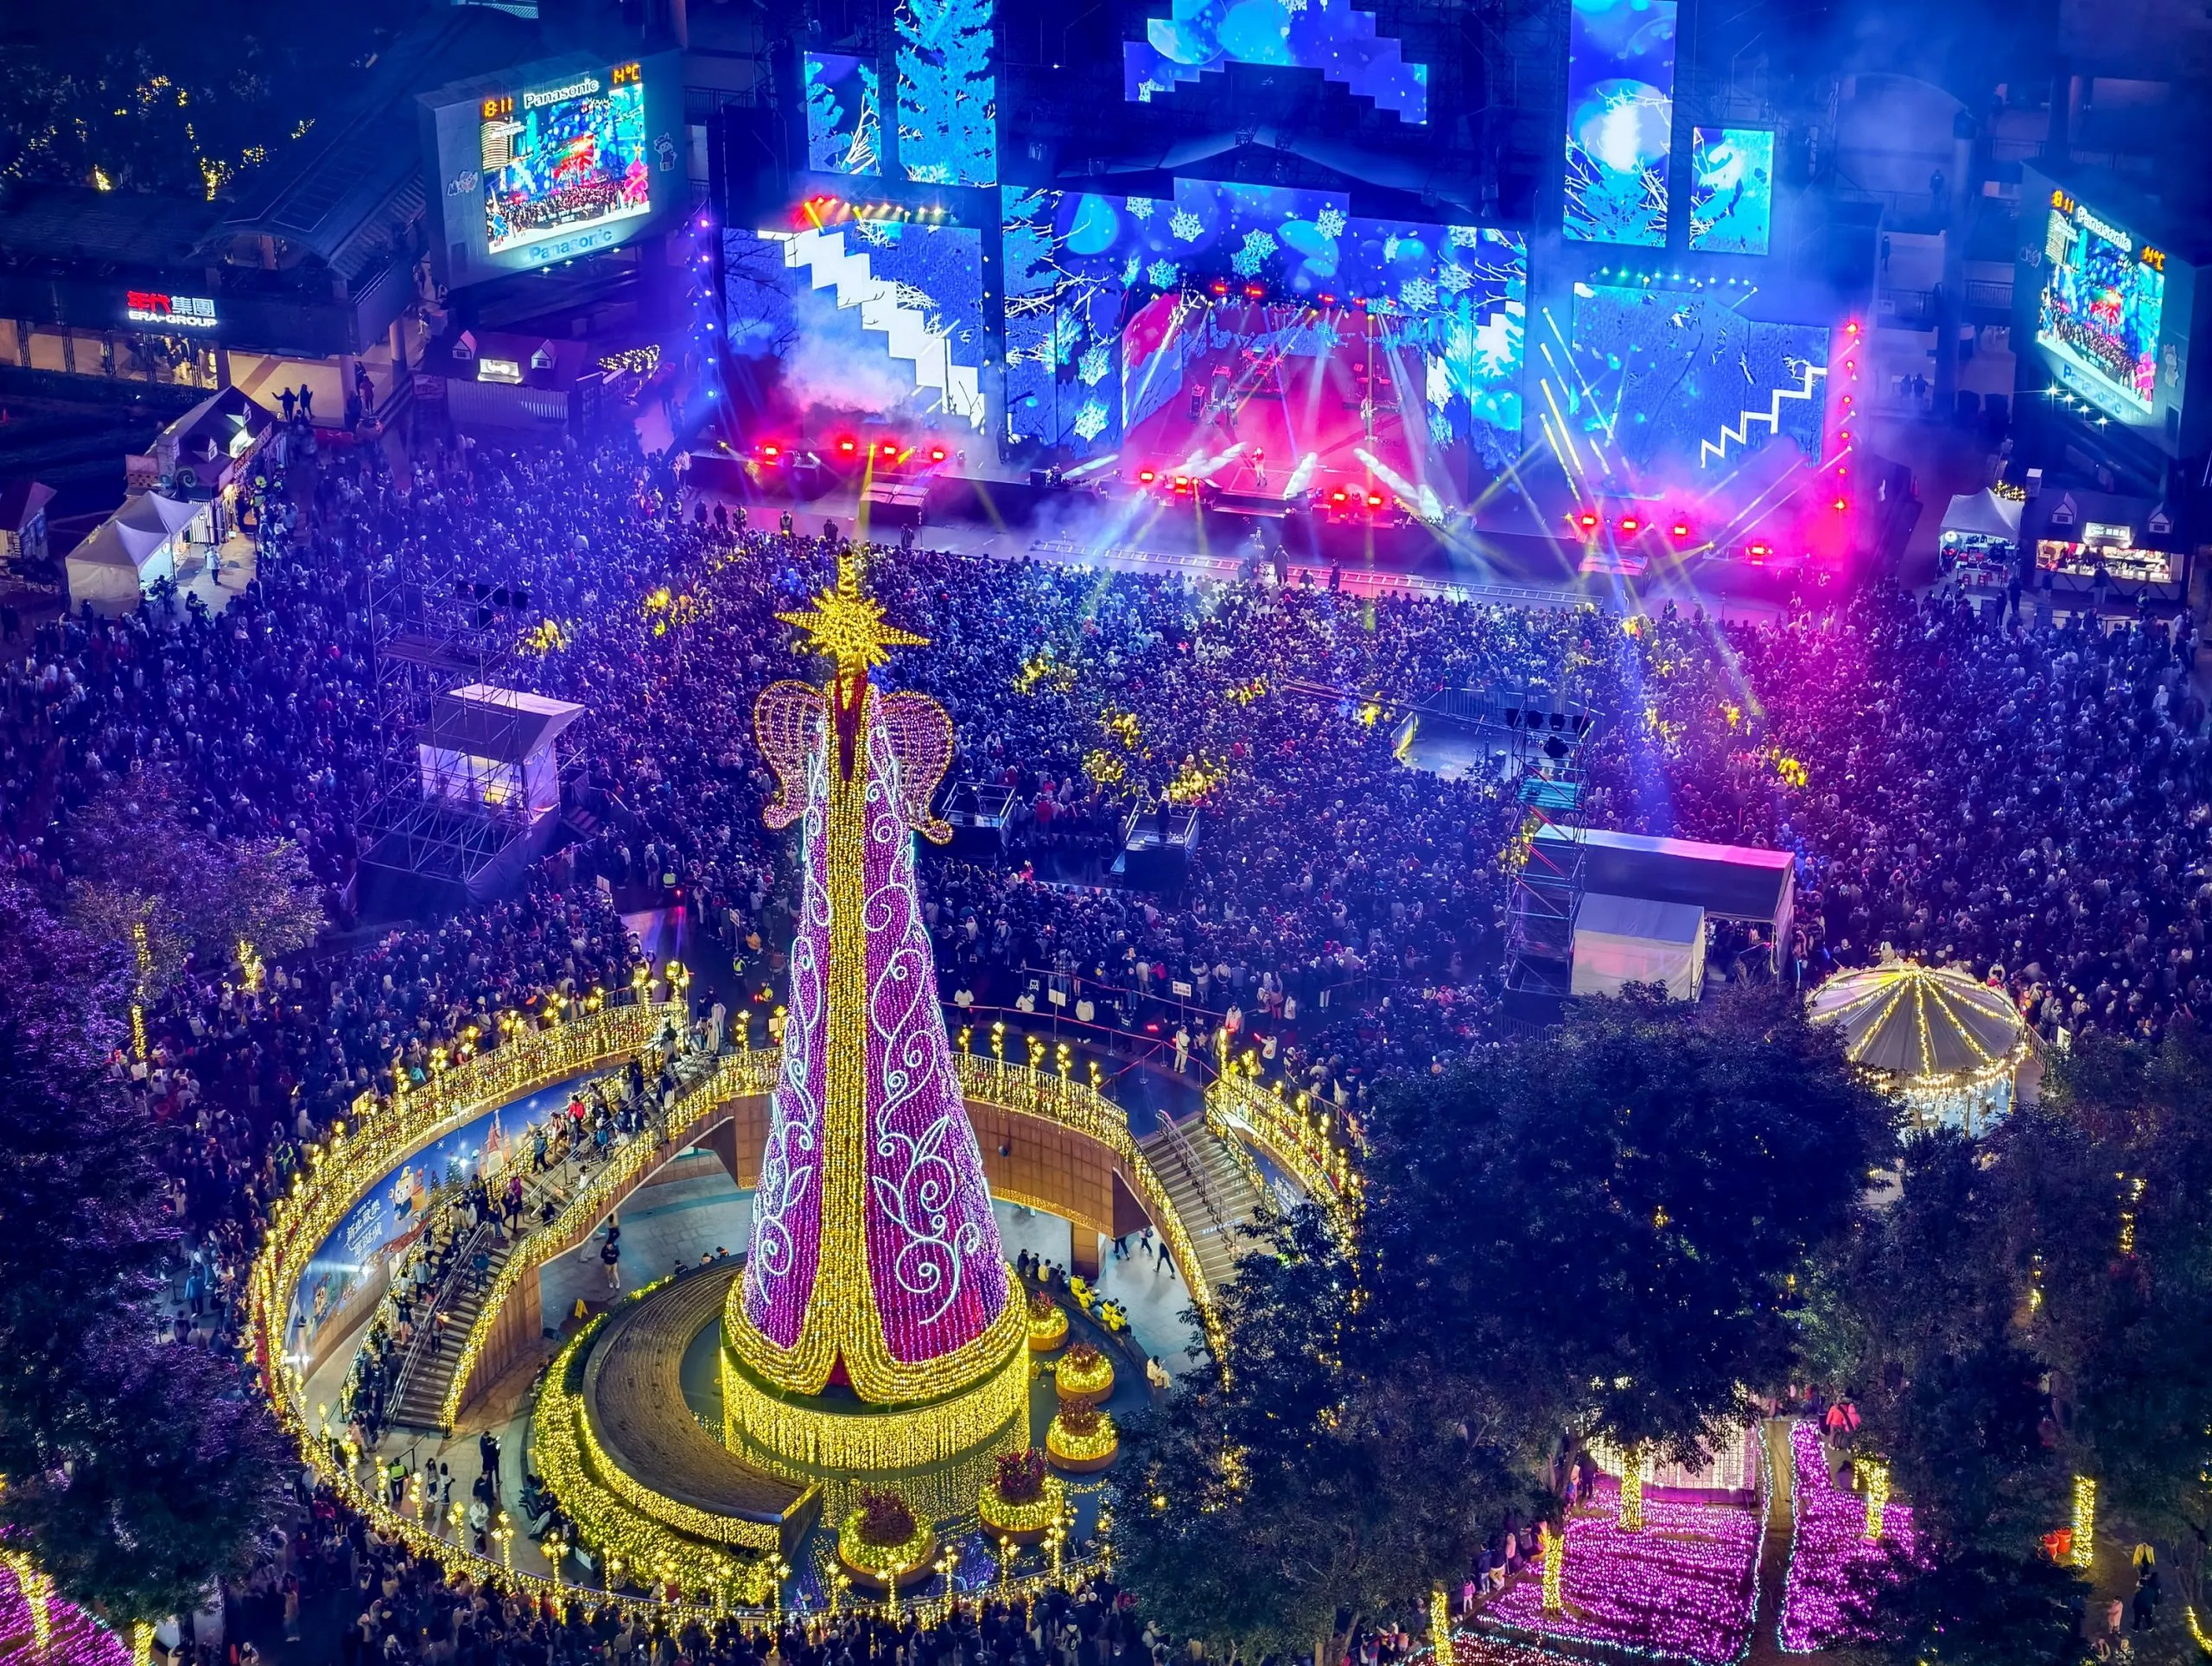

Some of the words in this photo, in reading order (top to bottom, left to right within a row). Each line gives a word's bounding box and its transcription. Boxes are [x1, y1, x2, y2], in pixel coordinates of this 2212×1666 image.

[524, 79, 600, 109] Panasonic
[528, 228, 613, 260] Panasonic
[2075, 205, 2132, 252] Panasonic
[127, 290, 215, 317] 年代集團
[2063, 364, 2122, 414] Panaoic
